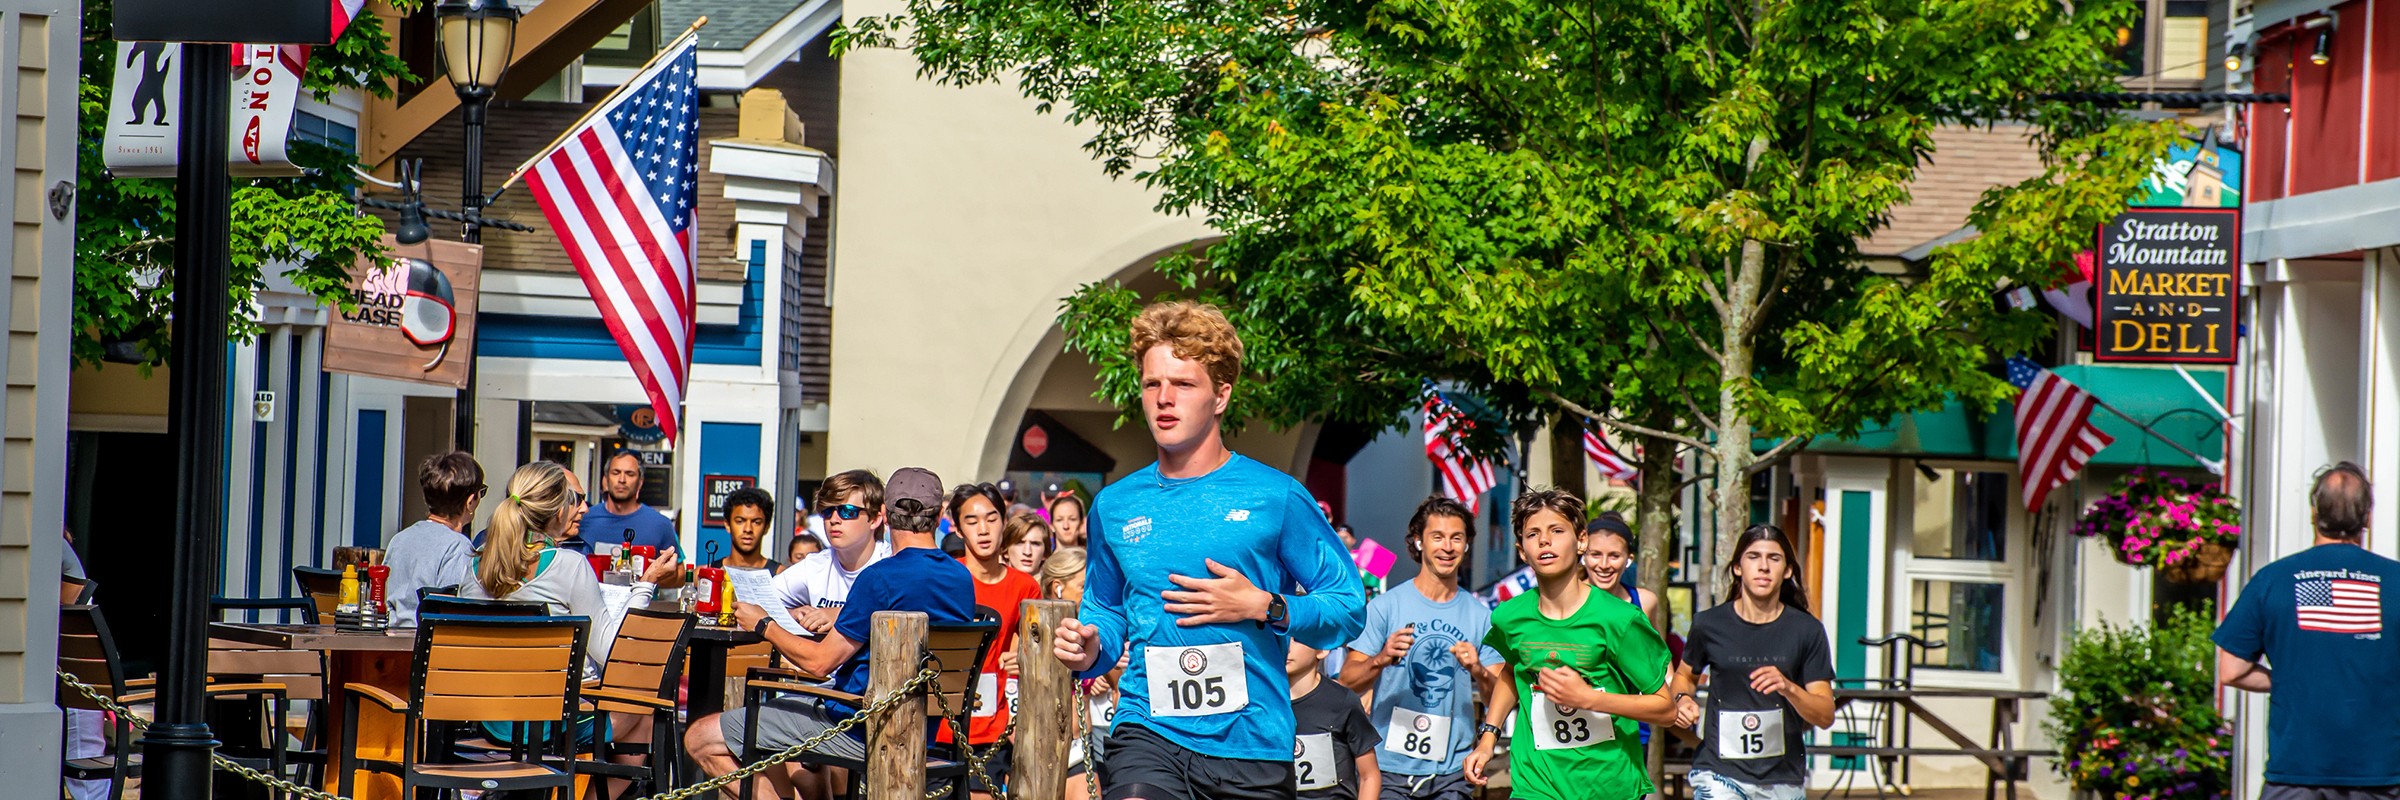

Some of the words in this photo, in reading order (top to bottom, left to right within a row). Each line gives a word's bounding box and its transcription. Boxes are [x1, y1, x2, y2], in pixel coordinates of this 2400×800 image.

[144, 146, 163, 154] 1961
[246, 125, 259, 158] VT
[2116, 218, 2219, 242] Stratton
[2107, 242, 2227, 266] Mountain
[2107, 268, 2231, 297] MARKET
[2110, 319, 2220, 354] DELI
[254, 393, 273, 402] AED
[715, 480, 744, 494] REST
[2294, 568, 2348, 580] vineyard
[2348, 570, 2381, 582] vines
[1167, 676, 1226, 710] 105
[1554, 717, 1590, 743] 83
[1404, 733, 1431, 755] 86
[1740, 733, 1764, 754] 15
